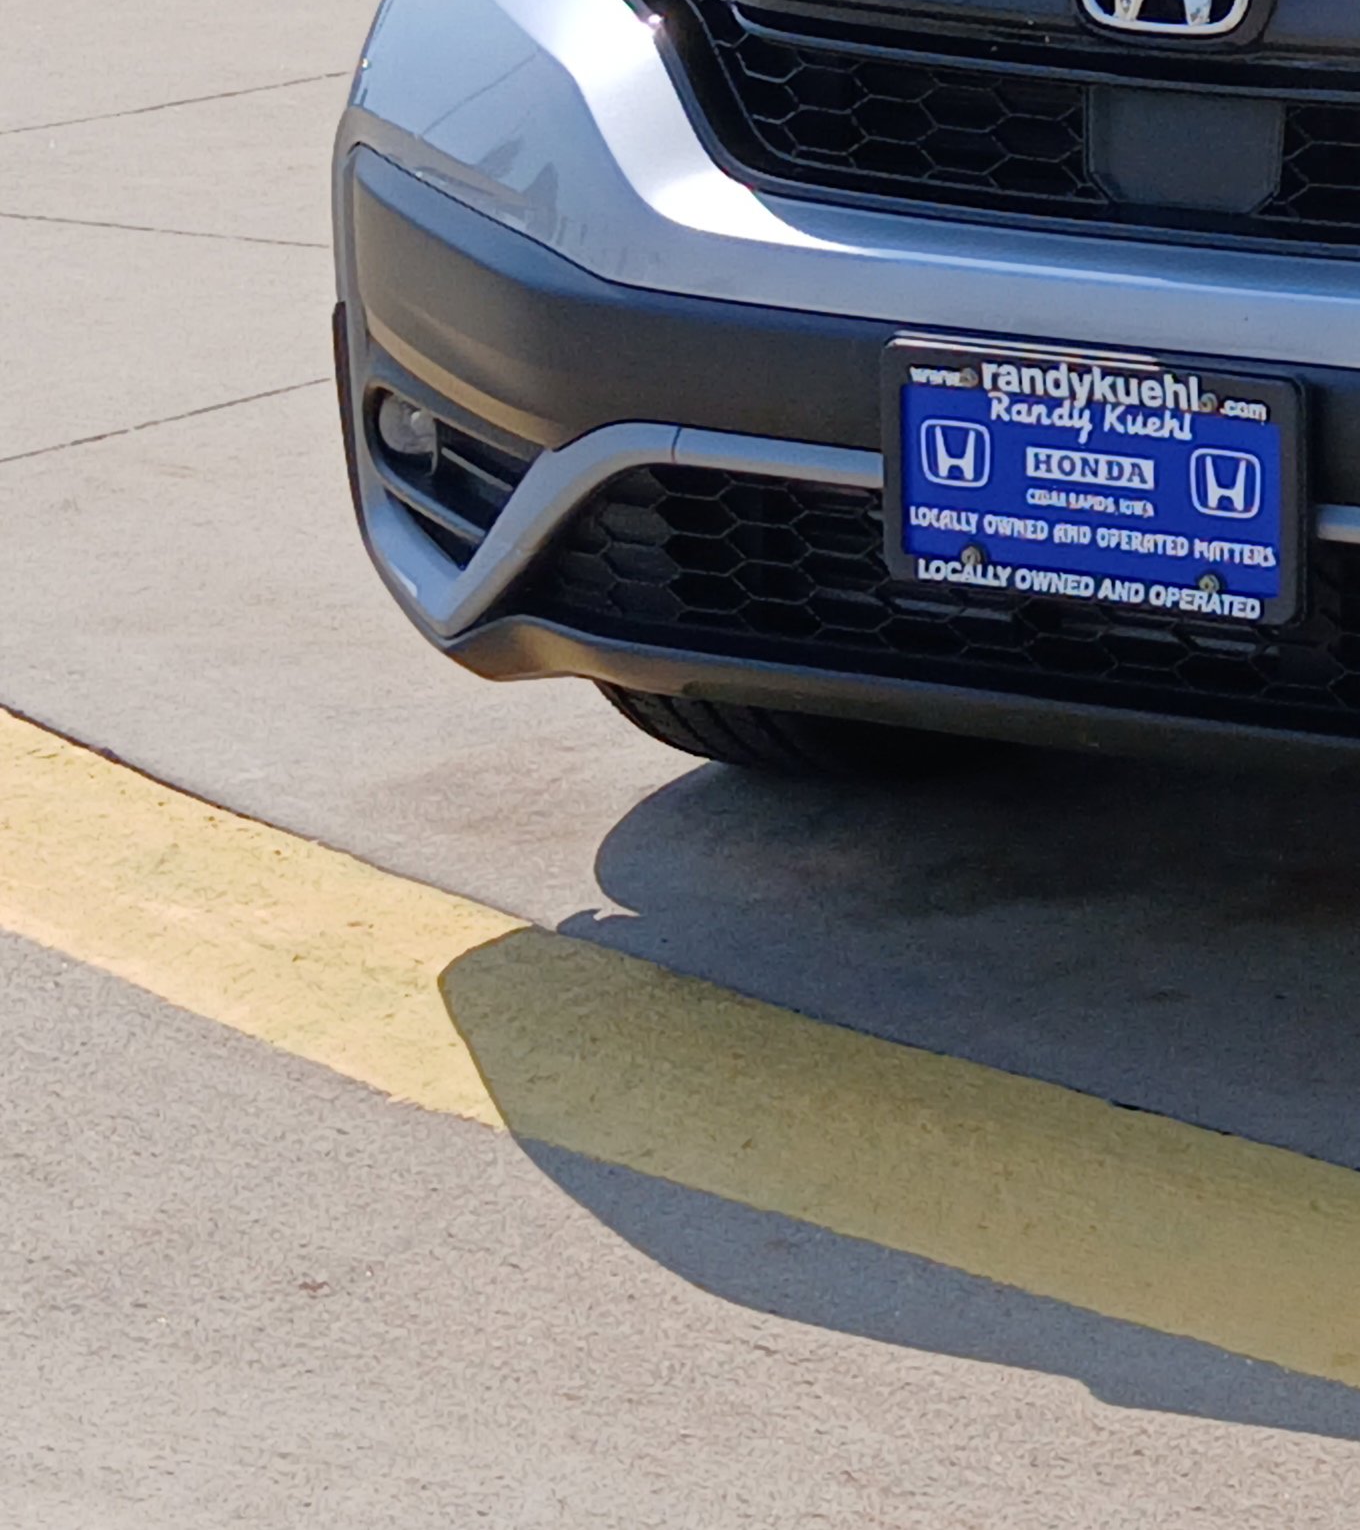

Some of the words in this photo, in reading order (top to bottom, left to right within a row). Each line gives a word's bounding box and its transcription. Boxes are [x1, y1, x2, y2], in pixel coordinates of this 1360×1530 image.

[981, 362, 1199, 412] randykuehl
[988, 391, 1093, 444] Randy
[1103, 404, 1192, 441] Kuehl
[1033, 452, 1148, 484] HONDA
[909, 505, 979, 535] LOCALLY
[983, 514, 1049, 541] OWNED
[1053, 523, 1091, 545] AND
[1096, 527, 1189, 557] OPERATED
[1193, 538, 1276, 567] MATTERS
[918, 558, 1012, 588] LOCALLY
[1015, 568, 1095, 597] OWNED
[1097, 578, 1145, 603] AND
[1149, 584, 1261, 619] OPERATED
